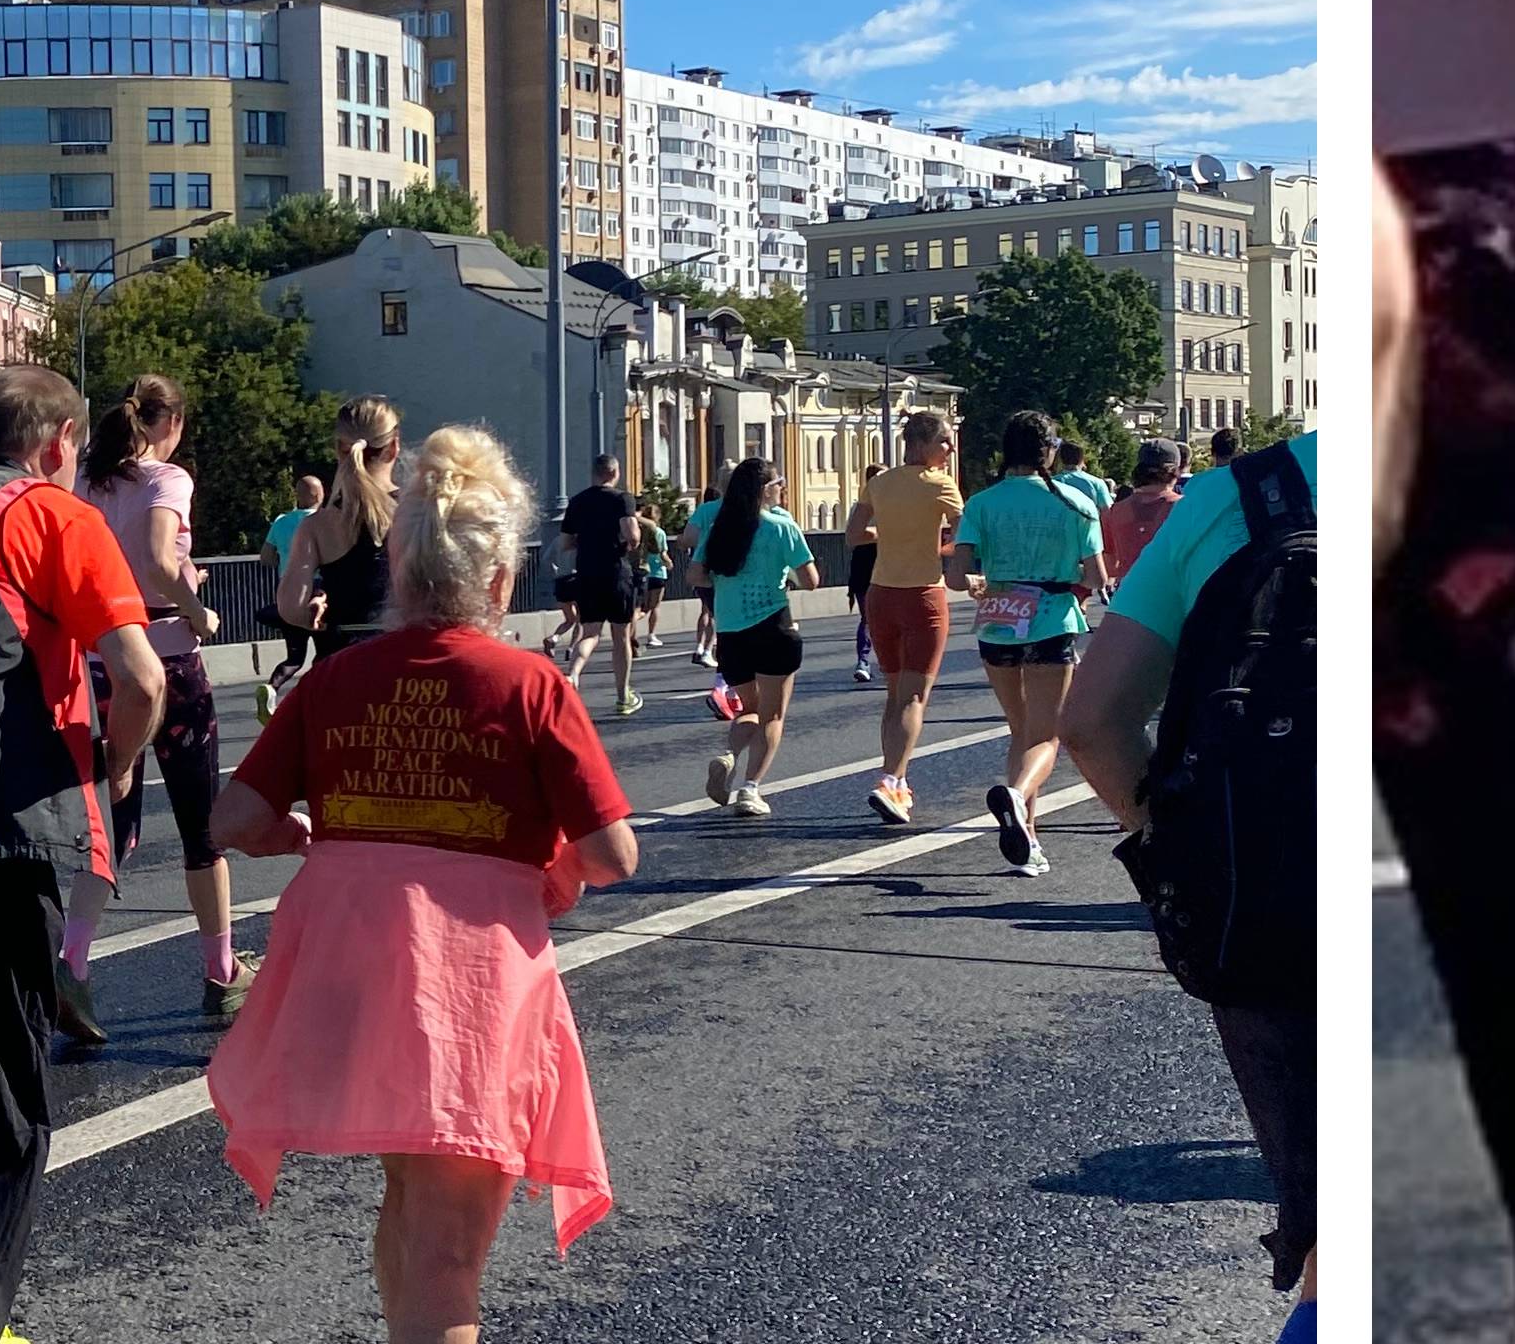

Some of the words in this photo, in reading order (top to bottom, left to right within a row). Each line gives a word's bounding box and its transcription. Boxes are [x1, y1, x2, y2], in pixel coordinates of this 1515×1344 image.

[978, 597, 1031, 618] 23946
[392, 677, 449, 705] 1989
[364, 703, 467, 728] MOSCOW
[325, 725, 508, 762] INTERNATIONAL
[373, 748, 446, 774] PEACE
[342, 769, 473, 798] MARATHON
